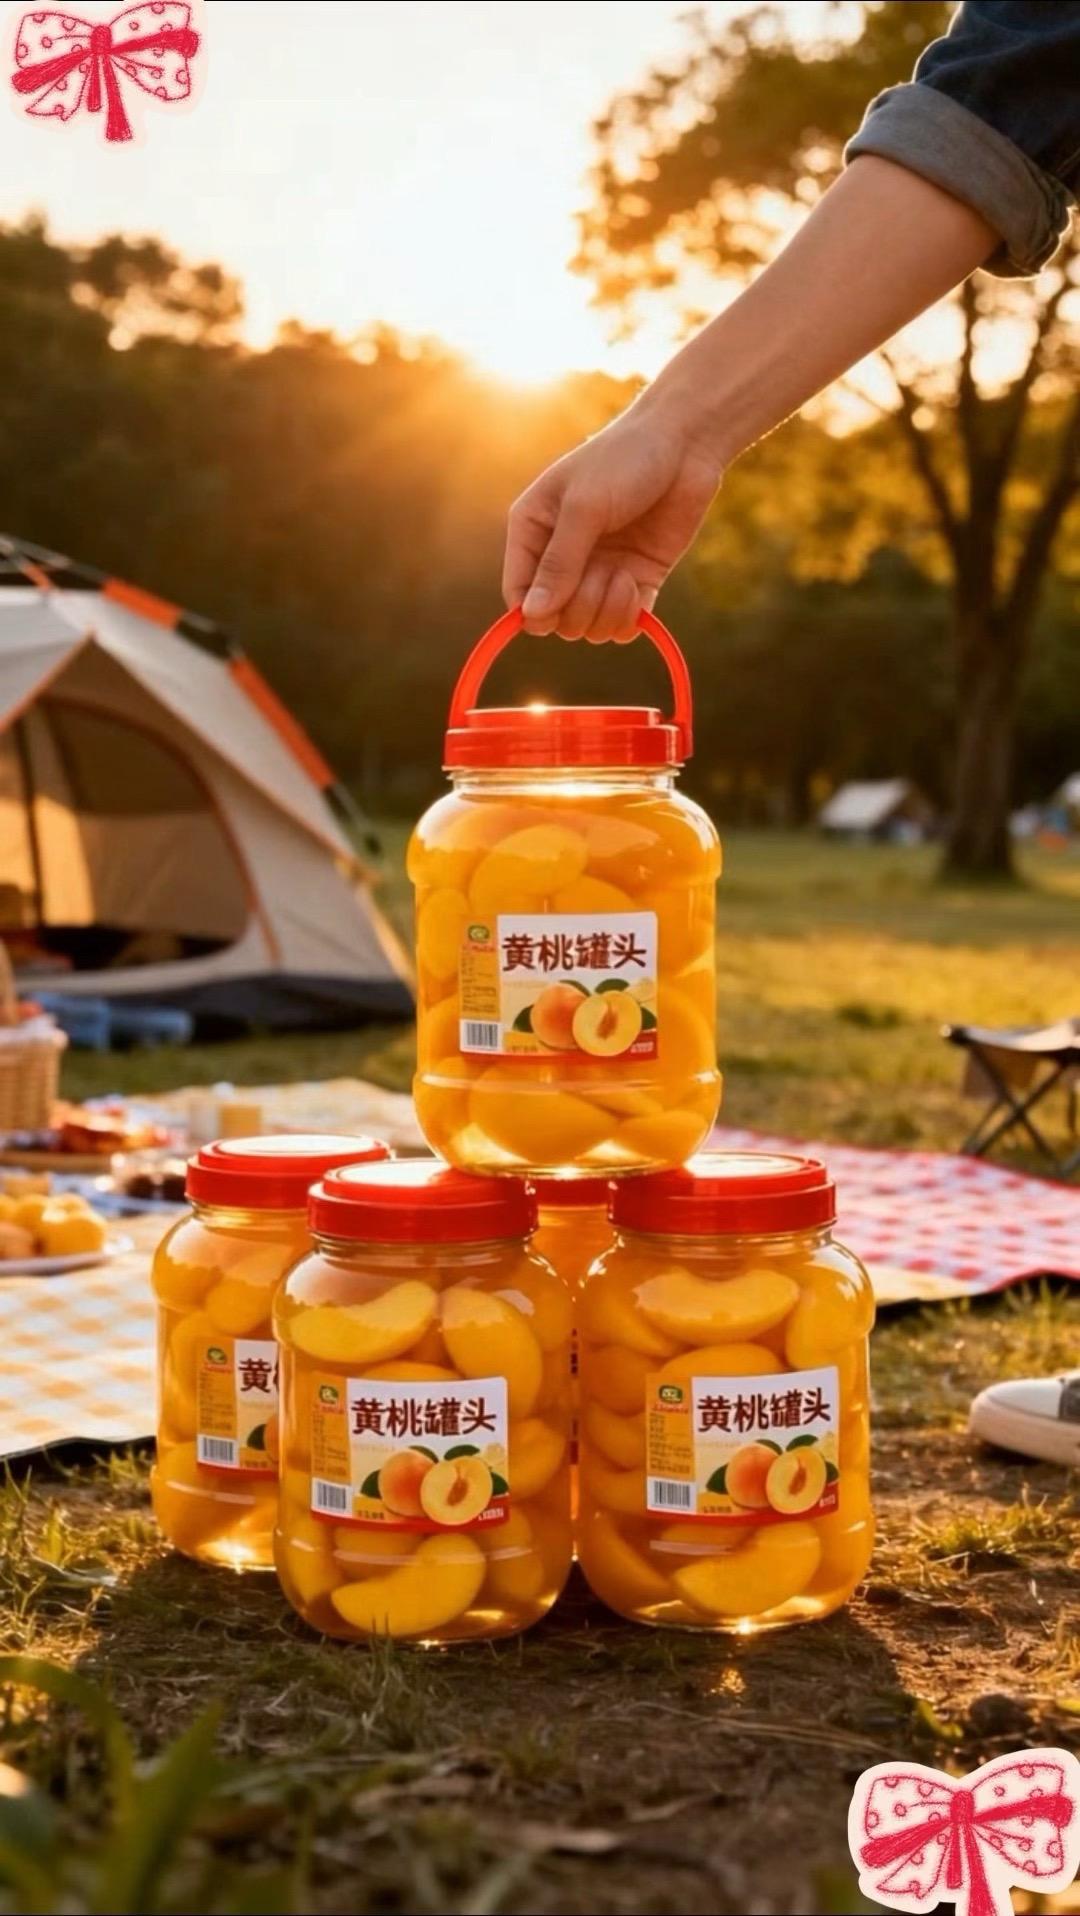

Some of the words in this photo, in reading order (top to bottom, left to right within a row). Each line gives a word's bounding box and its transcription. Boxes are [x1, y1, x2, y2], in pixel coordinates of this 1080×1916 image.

[502, 932, 647, 973] 黄桃罐头
[238, 1358, 279, 1393] 黄
[351, 1397, 497, 1438] 黄桃罐头
[697, 1387, 831, 1433] 黄桃罐头
